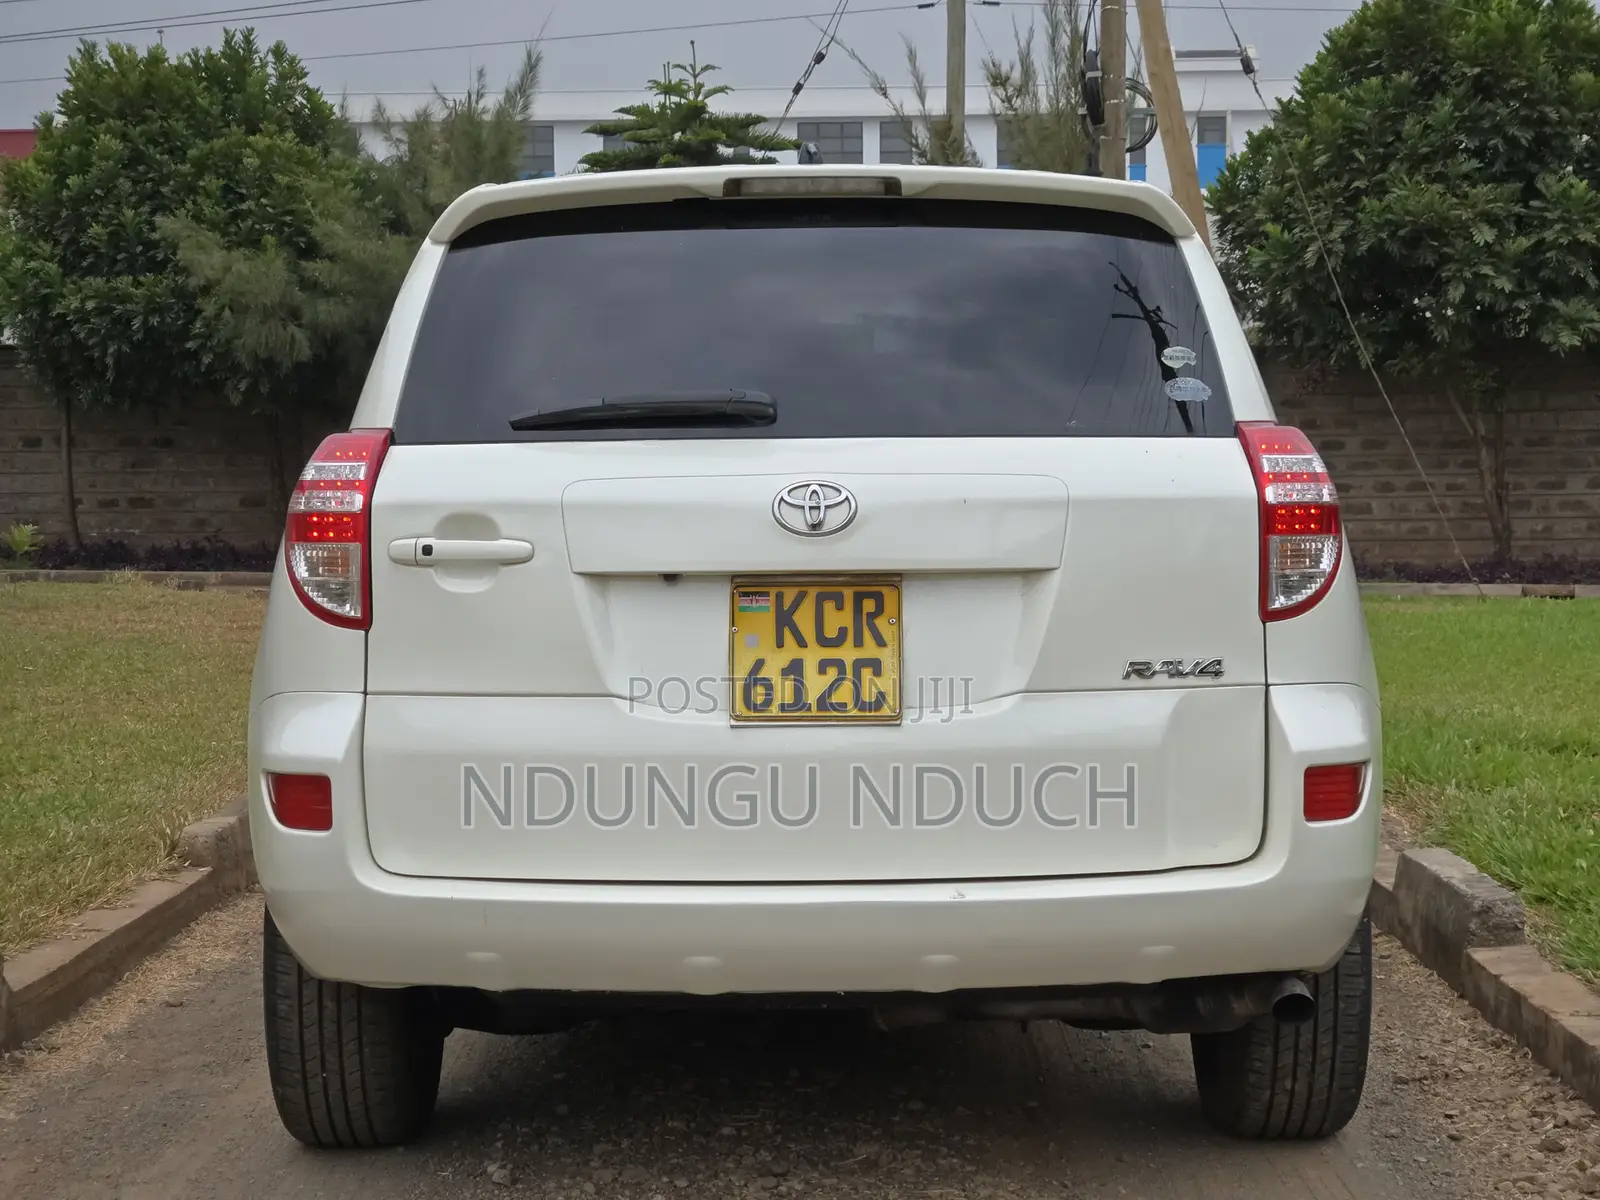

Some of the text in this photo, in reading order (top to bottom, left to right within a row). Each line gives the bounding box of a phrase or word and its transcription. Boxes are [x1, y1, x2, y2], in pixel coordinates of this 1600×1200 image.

[775, 590, 887, 648] KCR
[742, 657, 887, 713] 612C
[1122, 657, 1224, 680] RAV4
